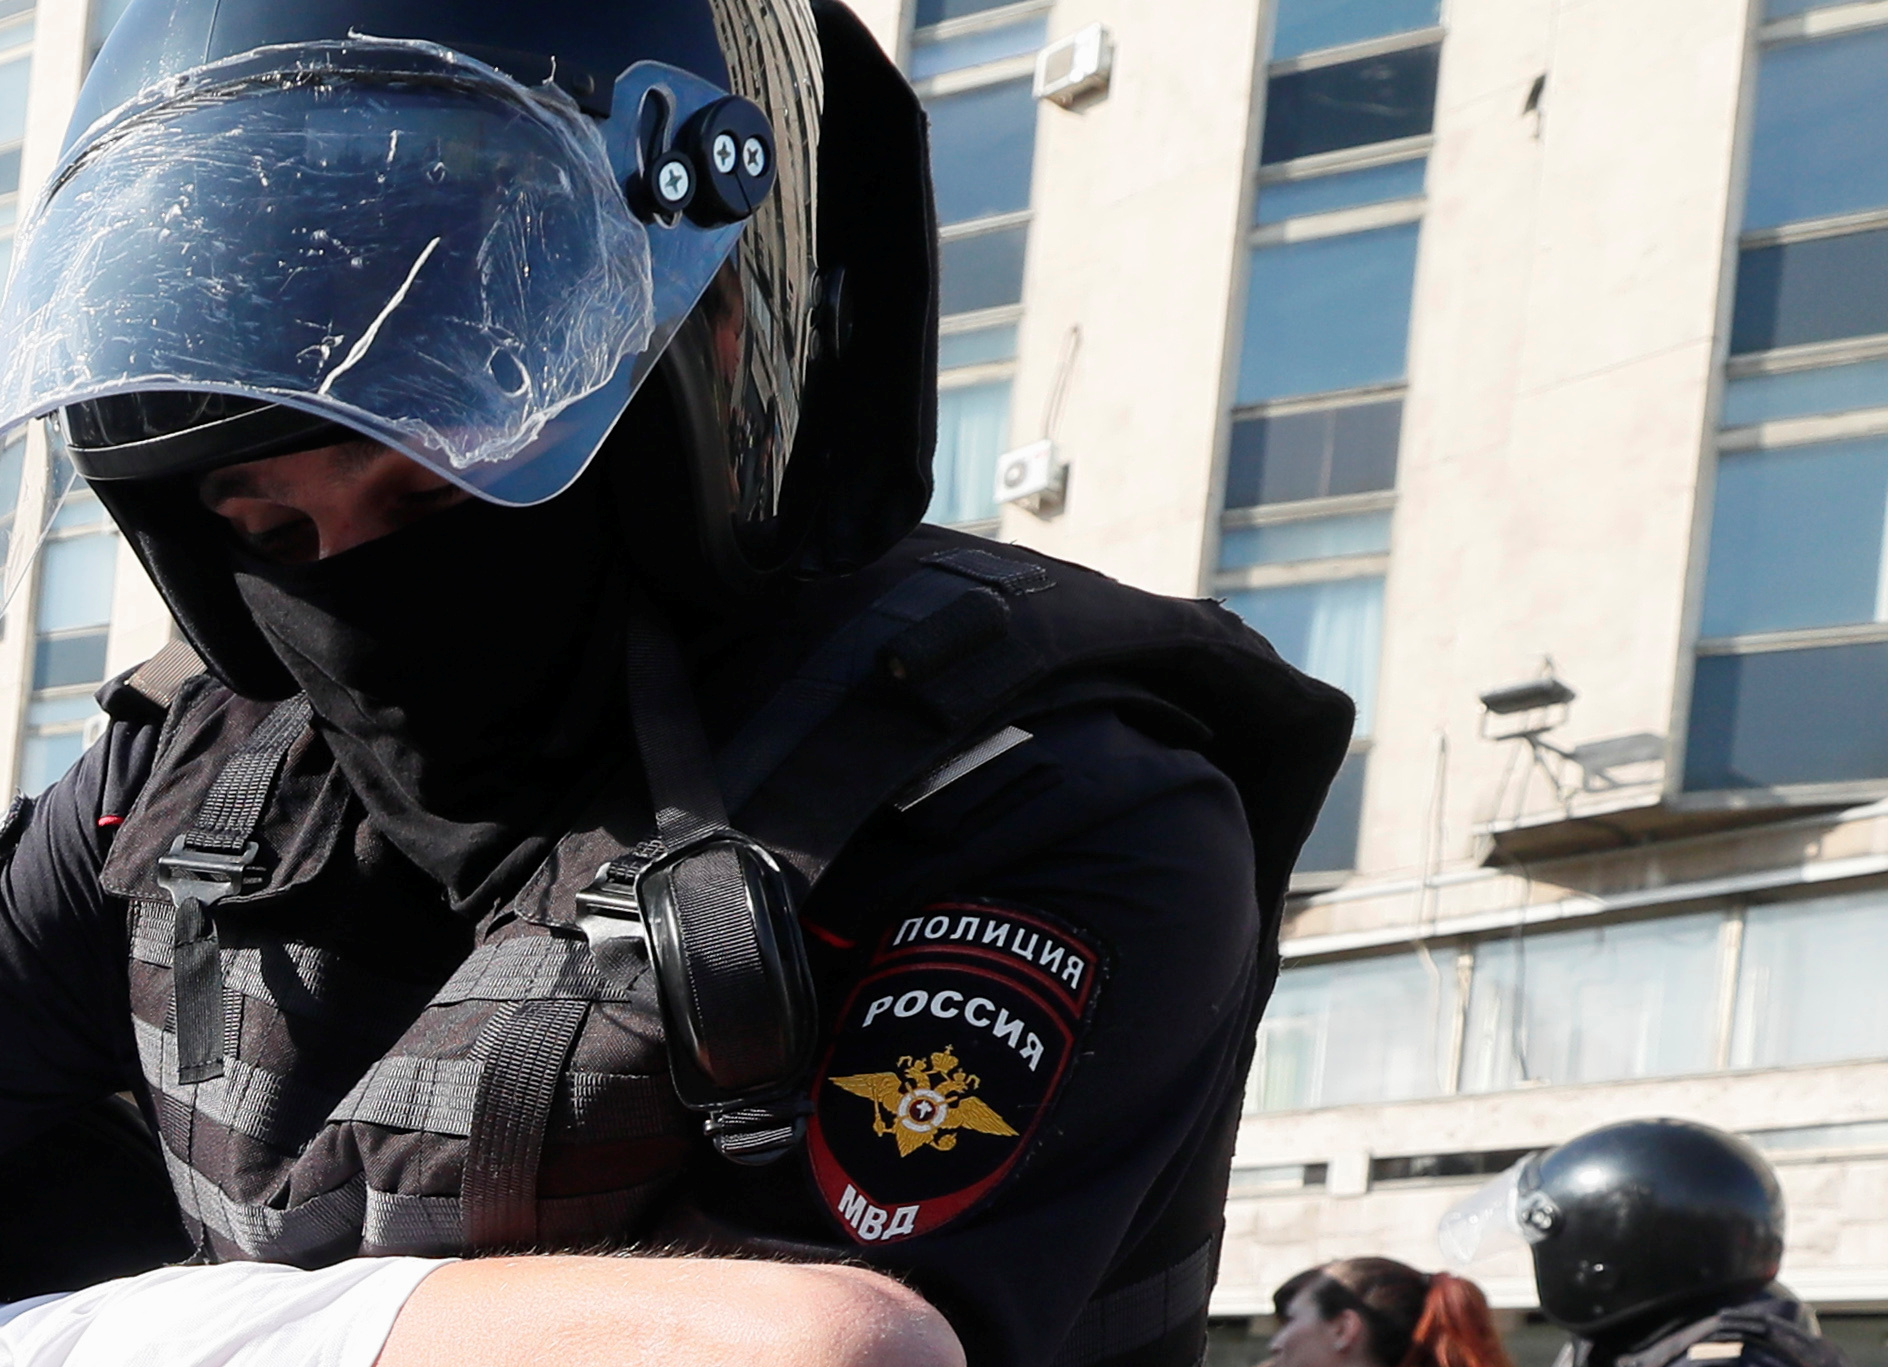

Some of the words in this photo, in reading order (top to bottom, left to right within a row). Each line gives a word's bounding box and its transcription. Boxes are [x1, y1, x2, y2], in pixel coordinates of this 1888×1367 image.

[892, 915, 1087, 991] ПОЛИЦИЯ
[861, 989, 1045, 1072] РОССИЯ
[837, 1183, 921, 1241] МВД
